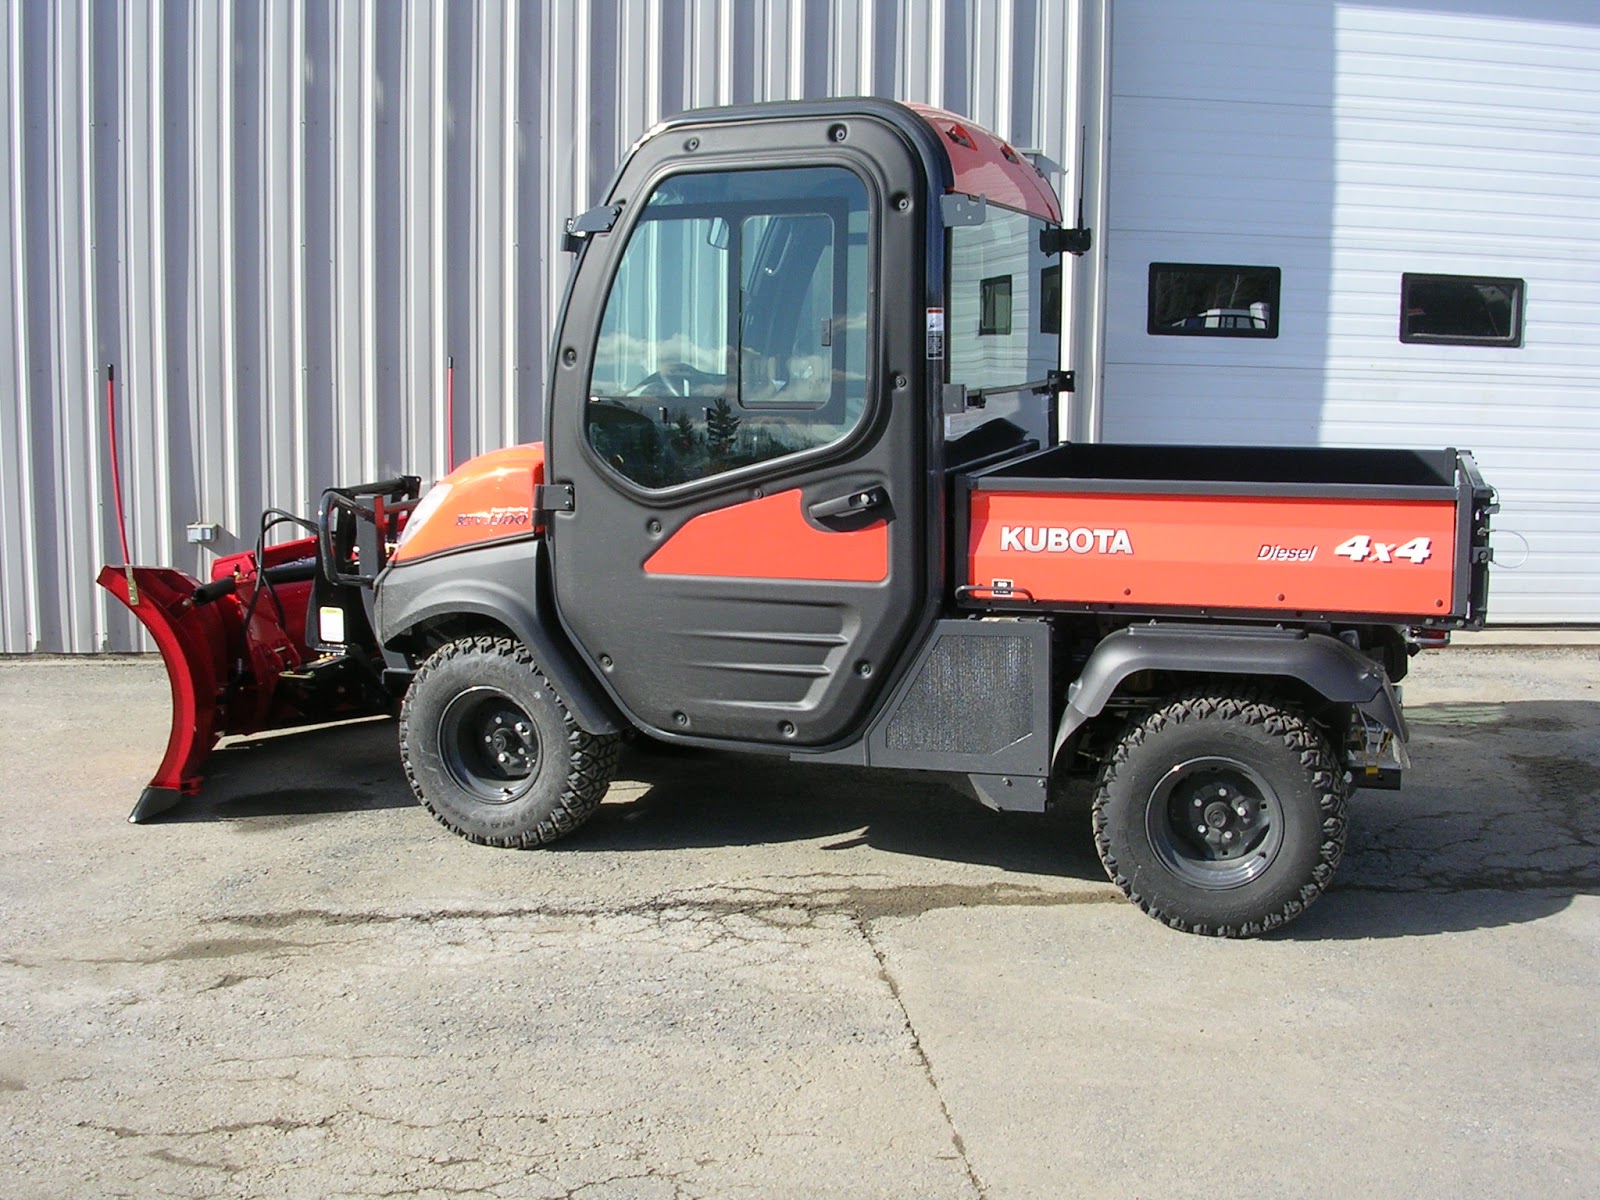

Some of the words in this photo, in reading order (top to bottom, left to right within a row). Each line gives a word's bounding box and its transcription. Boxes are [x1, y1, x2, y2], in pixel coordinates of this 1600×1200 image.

[1000, 525, 1134, 555] KUBOTA
[1257, 544, 1318, 562] Diesel
[1334, 534, 1432, 564] 4x4
